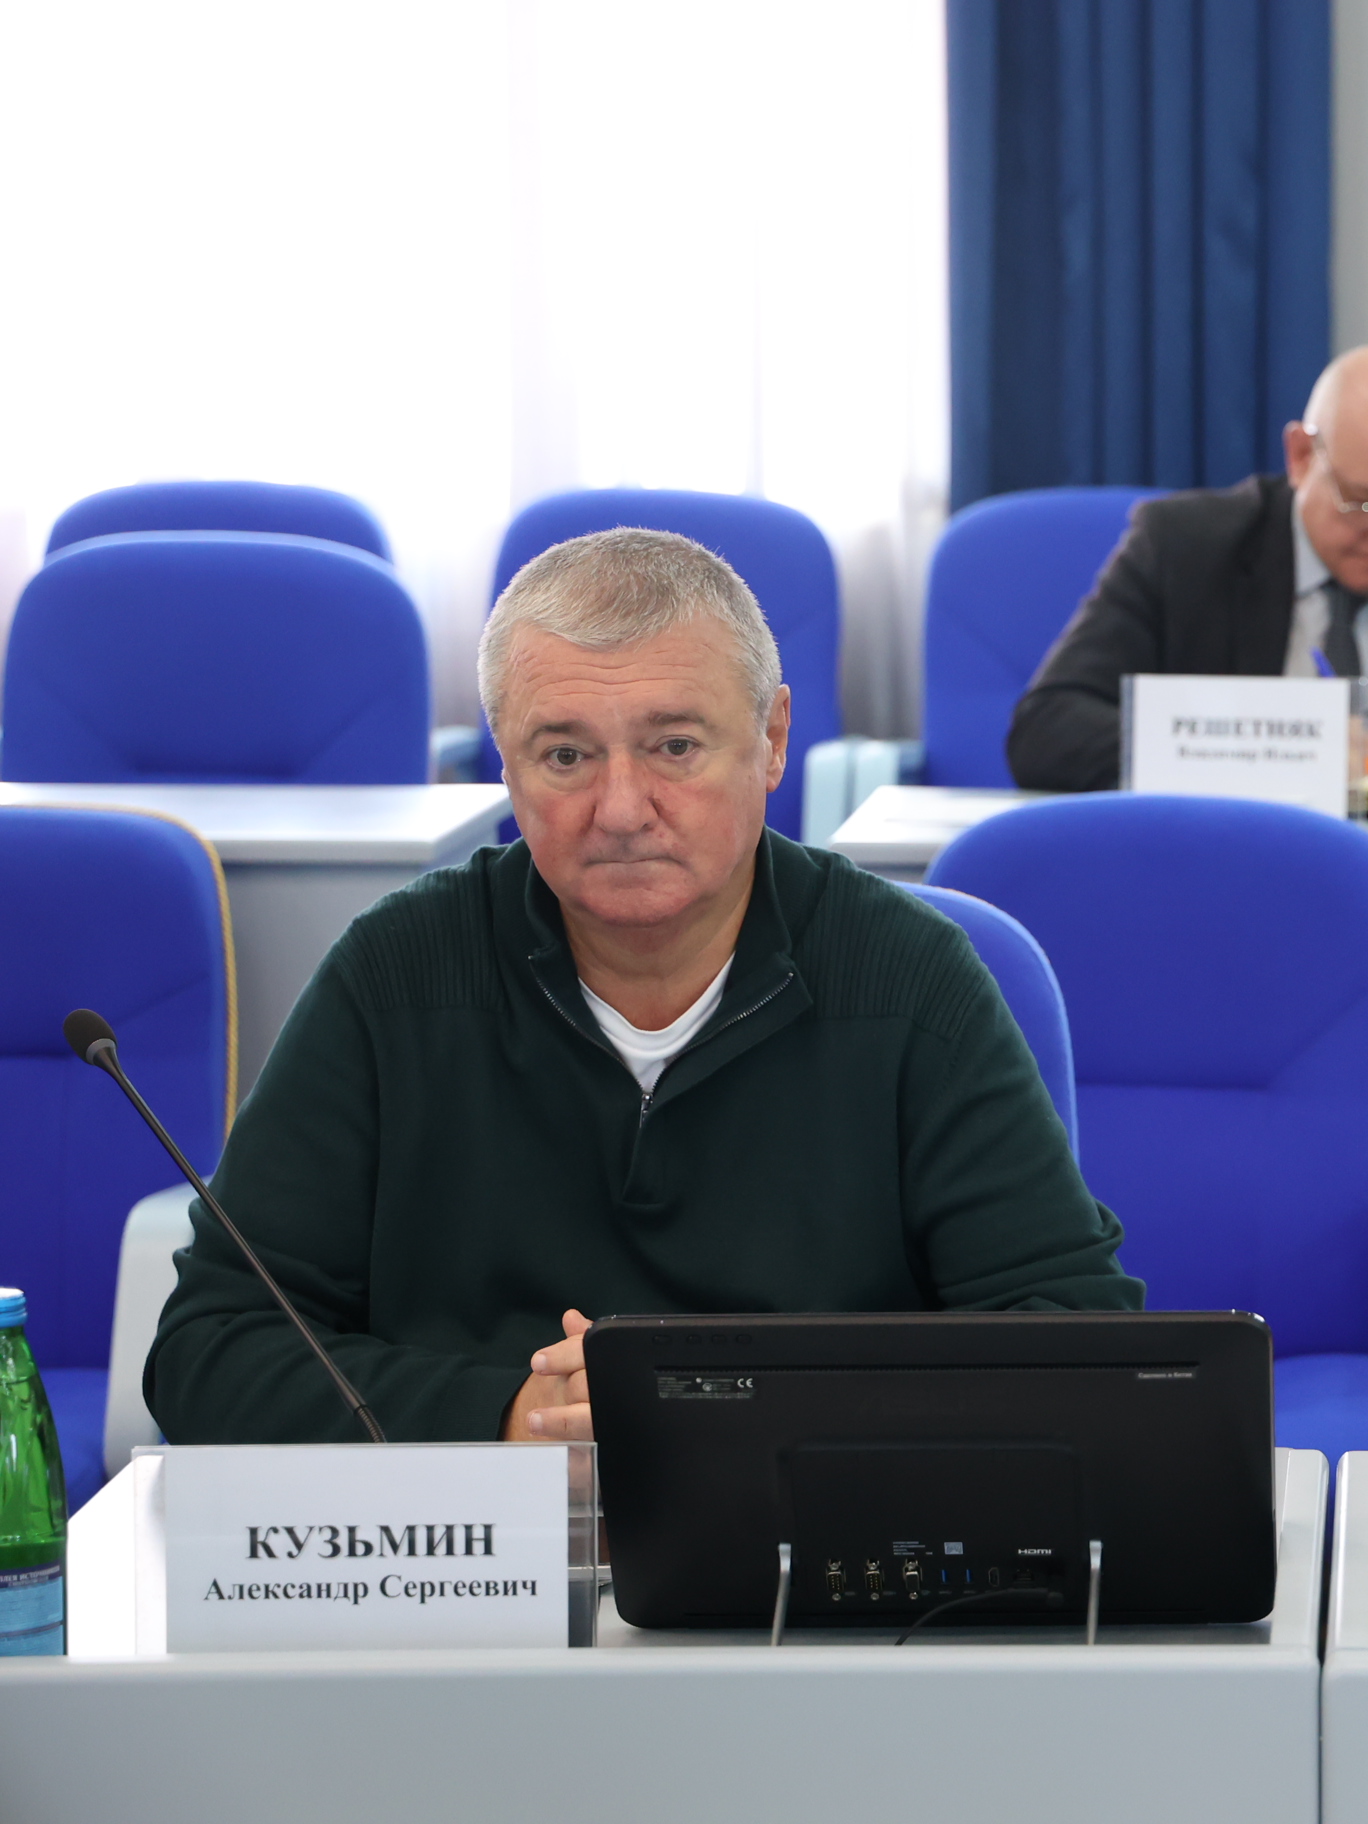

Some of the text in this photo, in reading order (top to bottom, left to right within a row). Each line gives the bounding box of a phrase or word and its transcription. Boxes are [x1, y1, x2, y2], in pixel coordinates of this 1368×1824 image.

[246, 1523, 496, 1560] КУЗЬМИН
[204, 1575, 538, 1604] Александр Сергеевич
